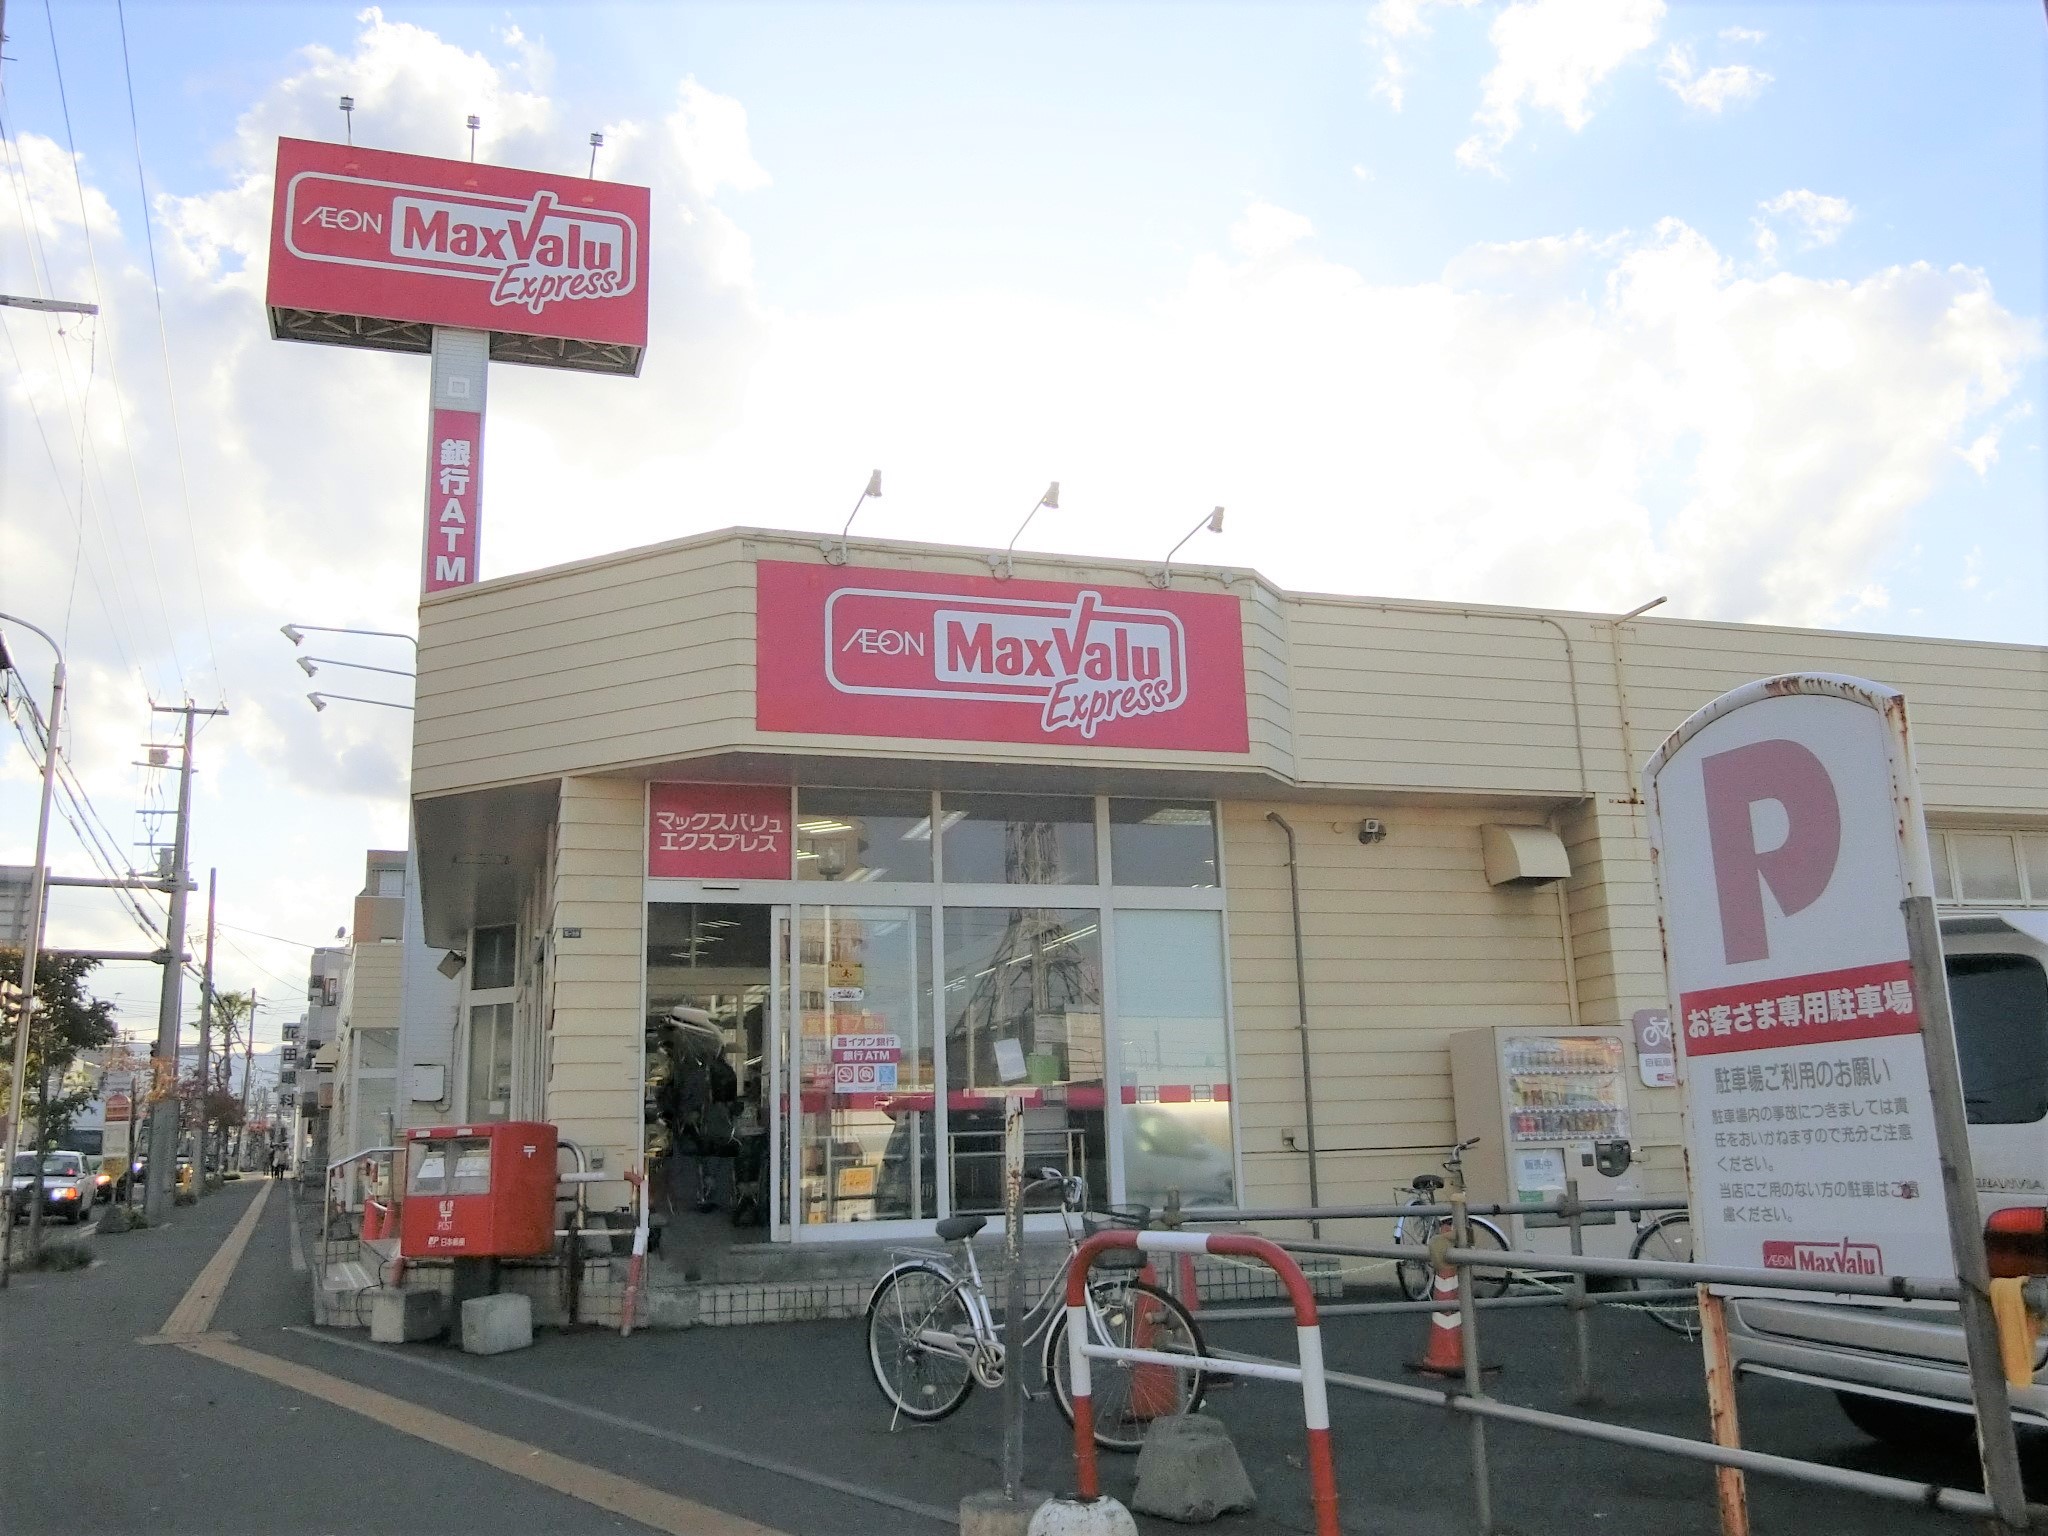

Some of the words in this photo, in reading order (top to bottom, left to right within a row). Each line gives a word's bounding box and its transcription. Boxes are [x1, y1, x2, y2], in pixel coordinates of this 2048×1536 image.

[403, 195, 612, 271] MaxValu
[494, 263, 619, 309] Express
[435, 438, 471, 583] 銀行ATM
[946, 596, 1161, 683] MaxValu
[1046, 677, 1170, 735] Express
[656, 811, 783, 833] マックスバリュ
[659, 832, 777, 853] エクスプレス
[1702, 739, 1841, 965] P
[1687, 979, 1914, 1039] お客さま専用駐車場
[842, 1050, 890, 1061] 銀行ATM
[848, 1036, 896, 1047] イオン銀行
[1714, 1057, 1892, 1095] 駐車場ご利用のお願い
[1712, 1097, 1910, 1125] 駐車場内の事故につきましては責
[1714, 1123, 1914, 1149] 任をおいかねますので充分ご注意
[1717, 1156, 1775, 1173] ください。
[1798, 1236, 1876, 1275] MaxValu
